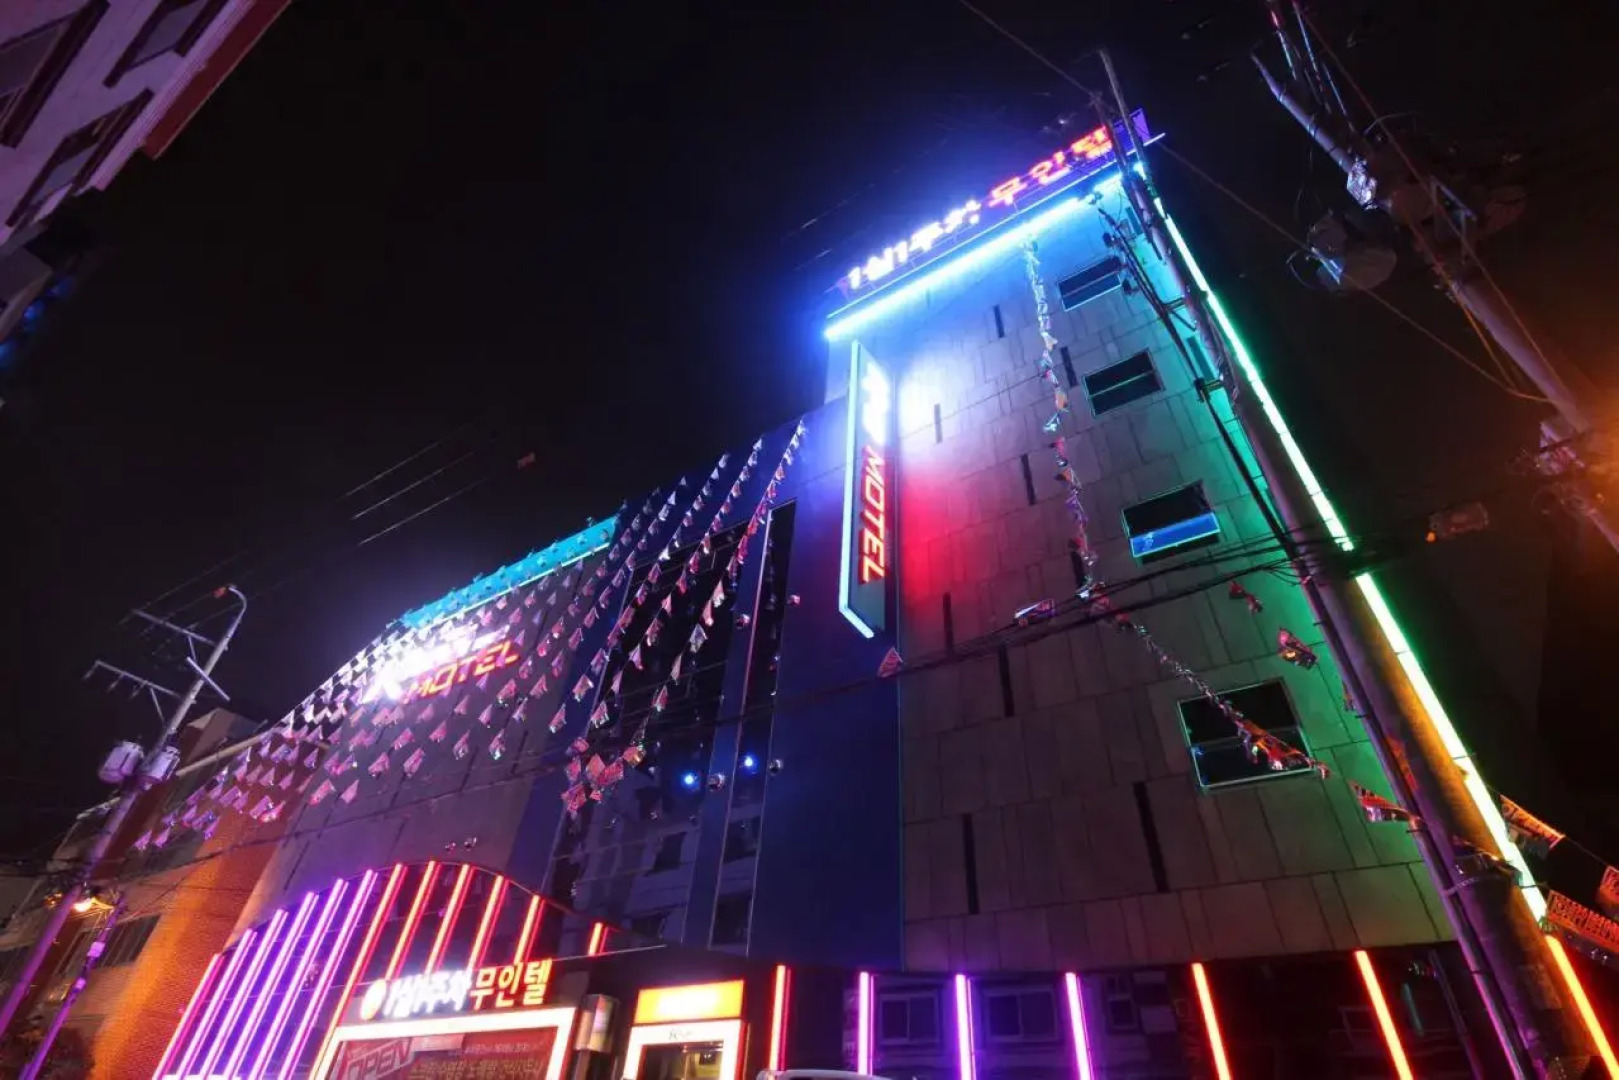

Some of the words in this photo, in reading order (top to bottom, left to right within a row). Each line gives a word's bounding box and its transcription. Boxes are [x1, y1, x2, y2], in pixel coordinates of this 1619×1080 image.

[989, 126, 1113, 206] 무인텔
[861, 446, 886, 583] MOTEL
[403, 641, 518, 703] MOTEL
[469, 958, 553, 1011] 무인텔
[347, 1041, 412, 1080] OPEN
